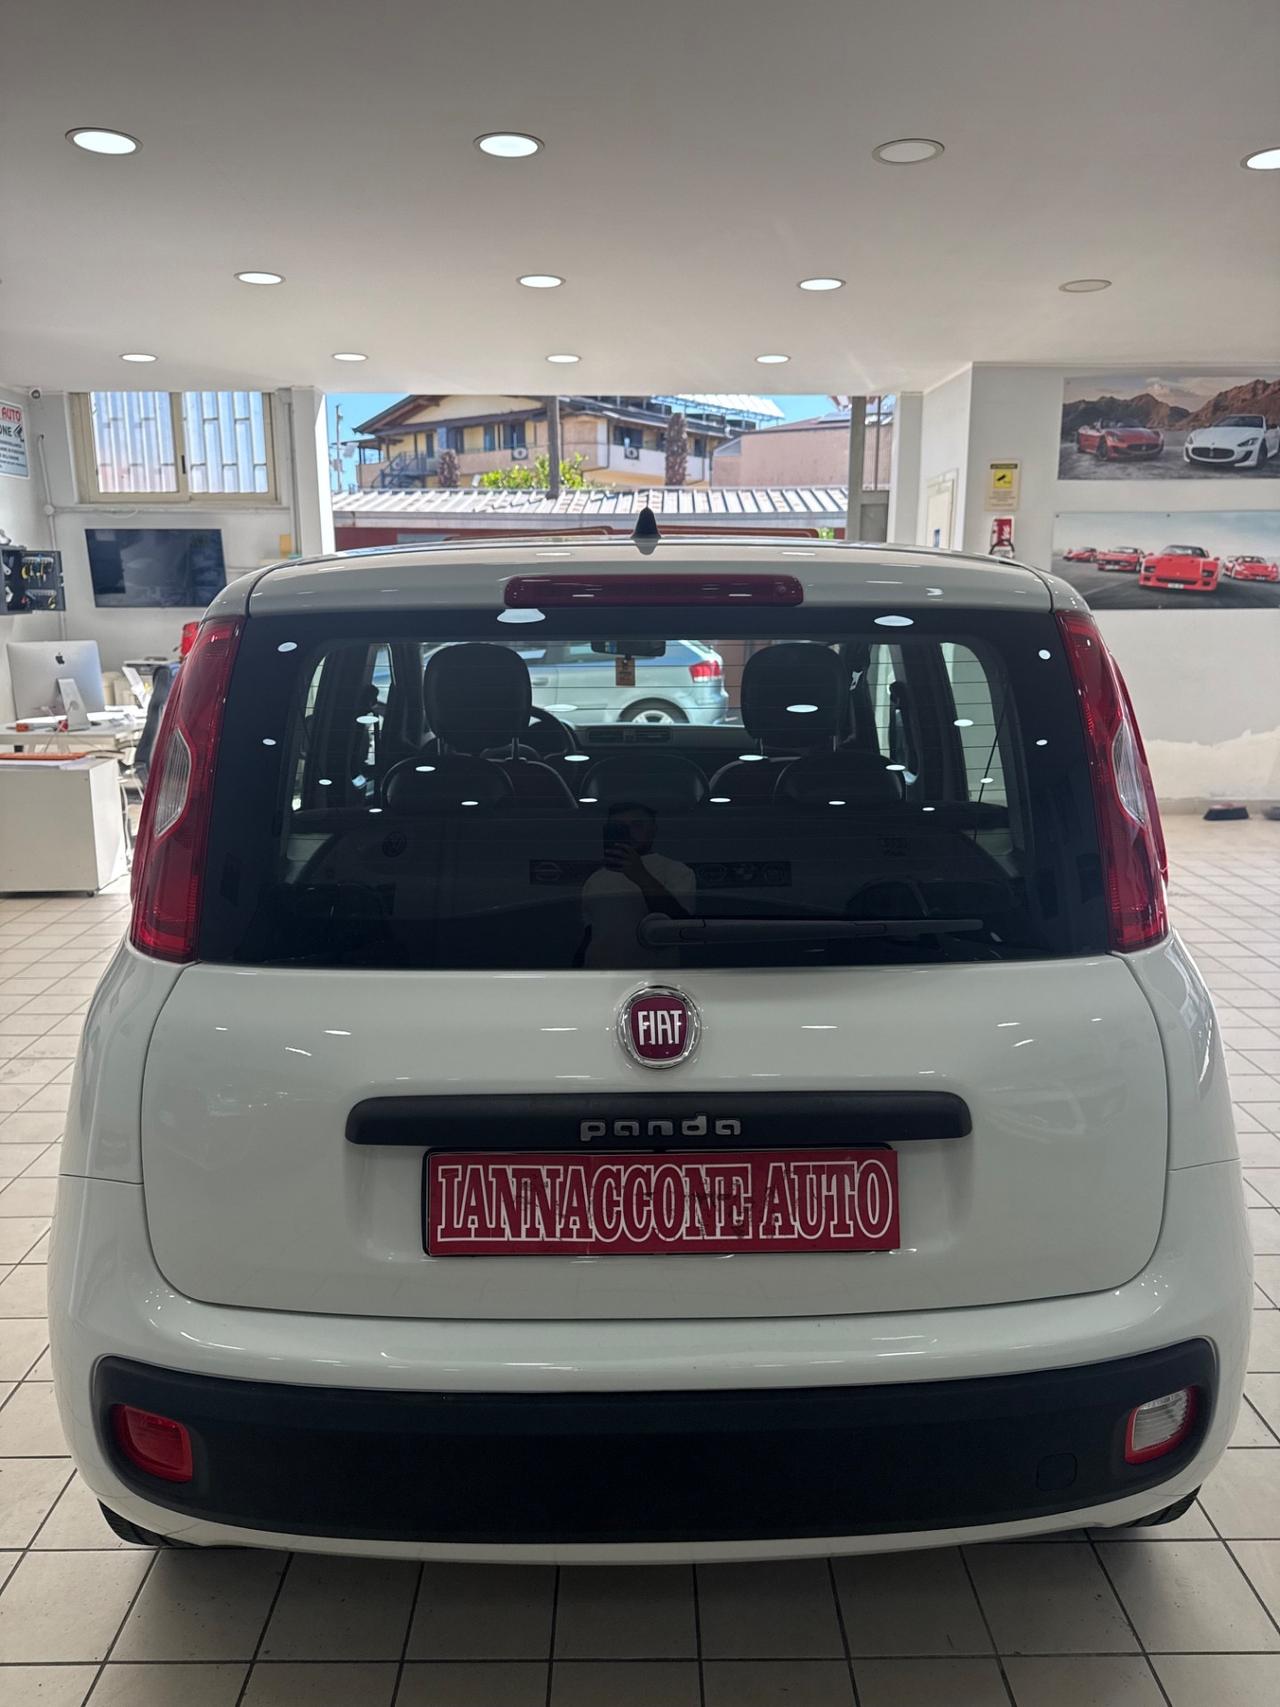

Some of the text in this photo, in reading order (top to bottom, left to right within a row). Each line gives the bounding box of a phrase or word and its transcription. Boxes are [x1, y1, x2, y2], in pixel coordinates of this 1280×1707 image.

[2, 407, 21, 422] AUTO
[637, 1009, 683, 1046] FIAT
[580, 1112, 743, 1141] panda
[437, 1159, 893, 1243] IANNACCONE AUTO
